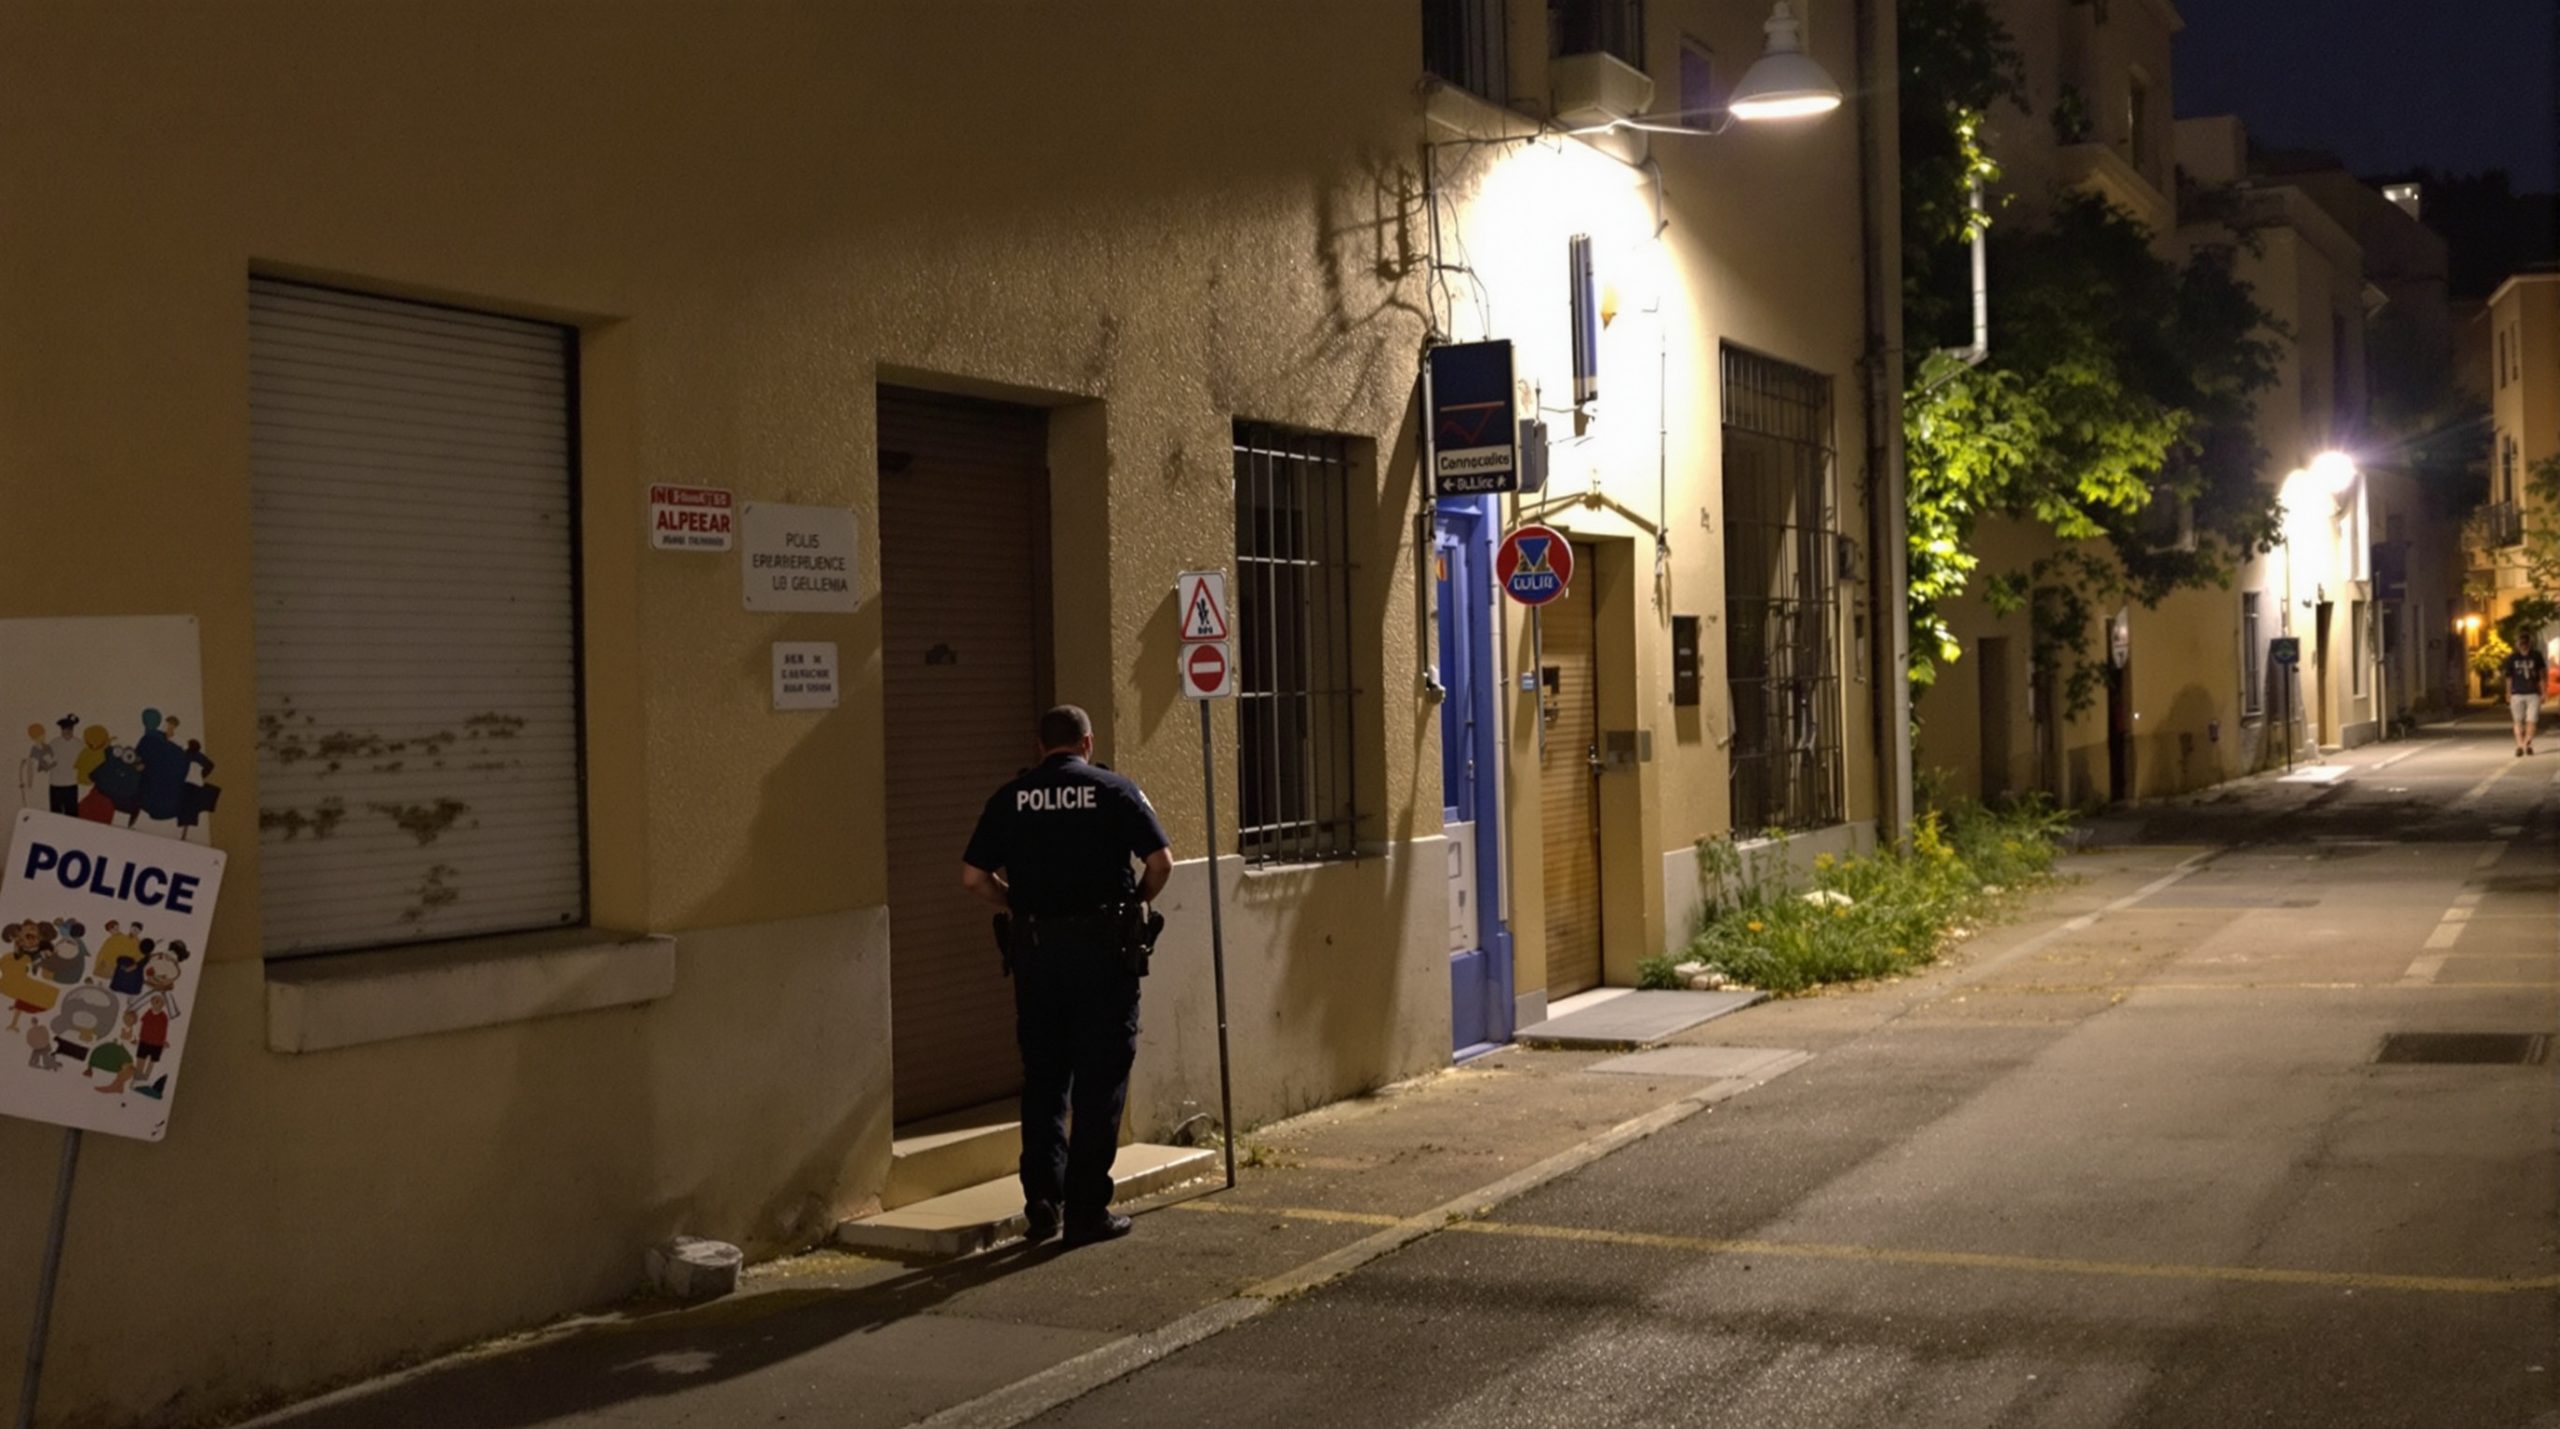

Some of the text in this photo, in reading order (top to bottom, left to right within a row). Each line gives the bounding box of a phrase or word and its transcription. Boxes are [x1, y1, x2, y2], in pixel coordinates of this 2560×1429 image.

[656, 510, 731, 533] ALPEEAR
[1016, 786, 1097, 811] POLICIE
[24, 842, 201, 914] POLICE
